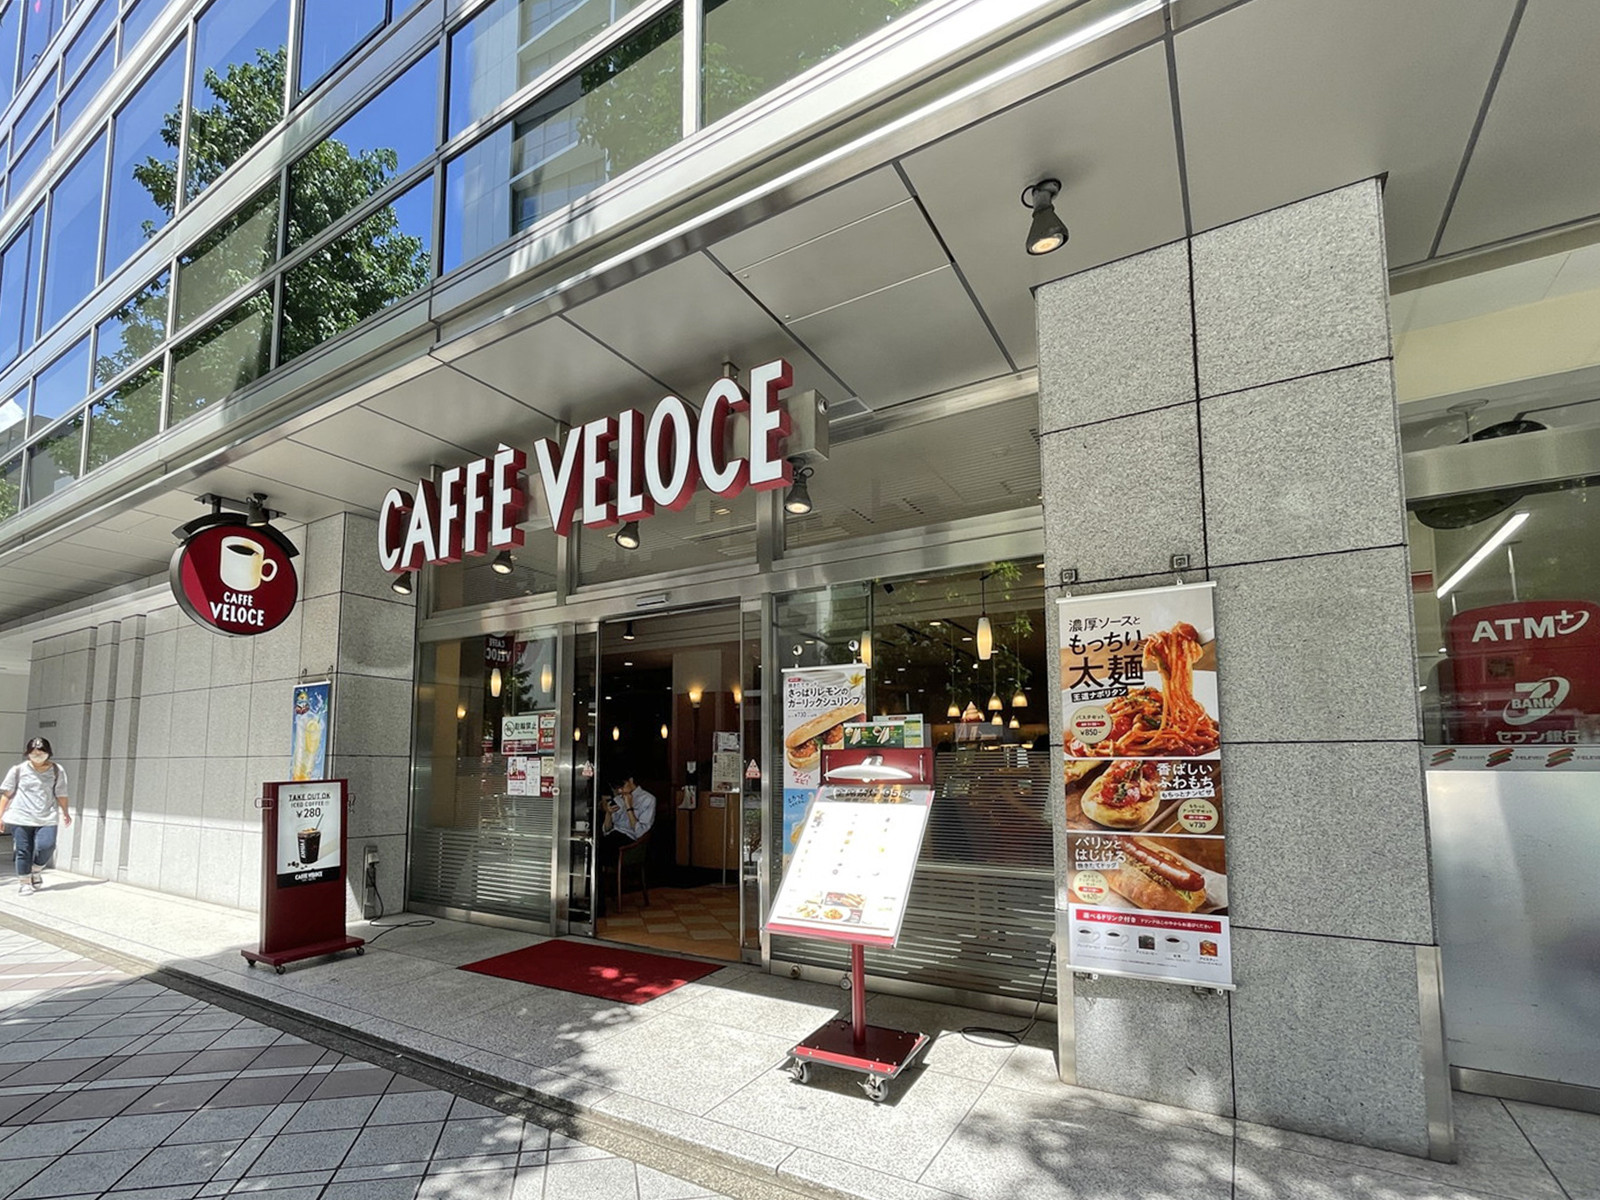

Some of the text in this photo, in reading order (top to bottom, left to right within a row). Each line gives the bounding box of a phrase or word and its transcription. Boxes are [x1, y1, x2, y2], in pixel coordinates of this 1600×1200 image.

[534, 358, 789, 536] VELOCE
[209, 601, 265, 626] VELOCE
[1068, 616, 1141, 633] 濃厚ソースと
[1068, 630, 1143, 655] もっちり
[1069, 653, 1146, 690] 太麺
[788, 686, 849, 698] さっぱりレモンの
[1511, 698, 1557, 709] BANK
[1156, 762, 1213, 776] 香ばしい
[1157, 775, 1214, 789] ふわもち
[296, 808, 321, 818] ¥280
[1074, 848, 1127, 863] はじける
